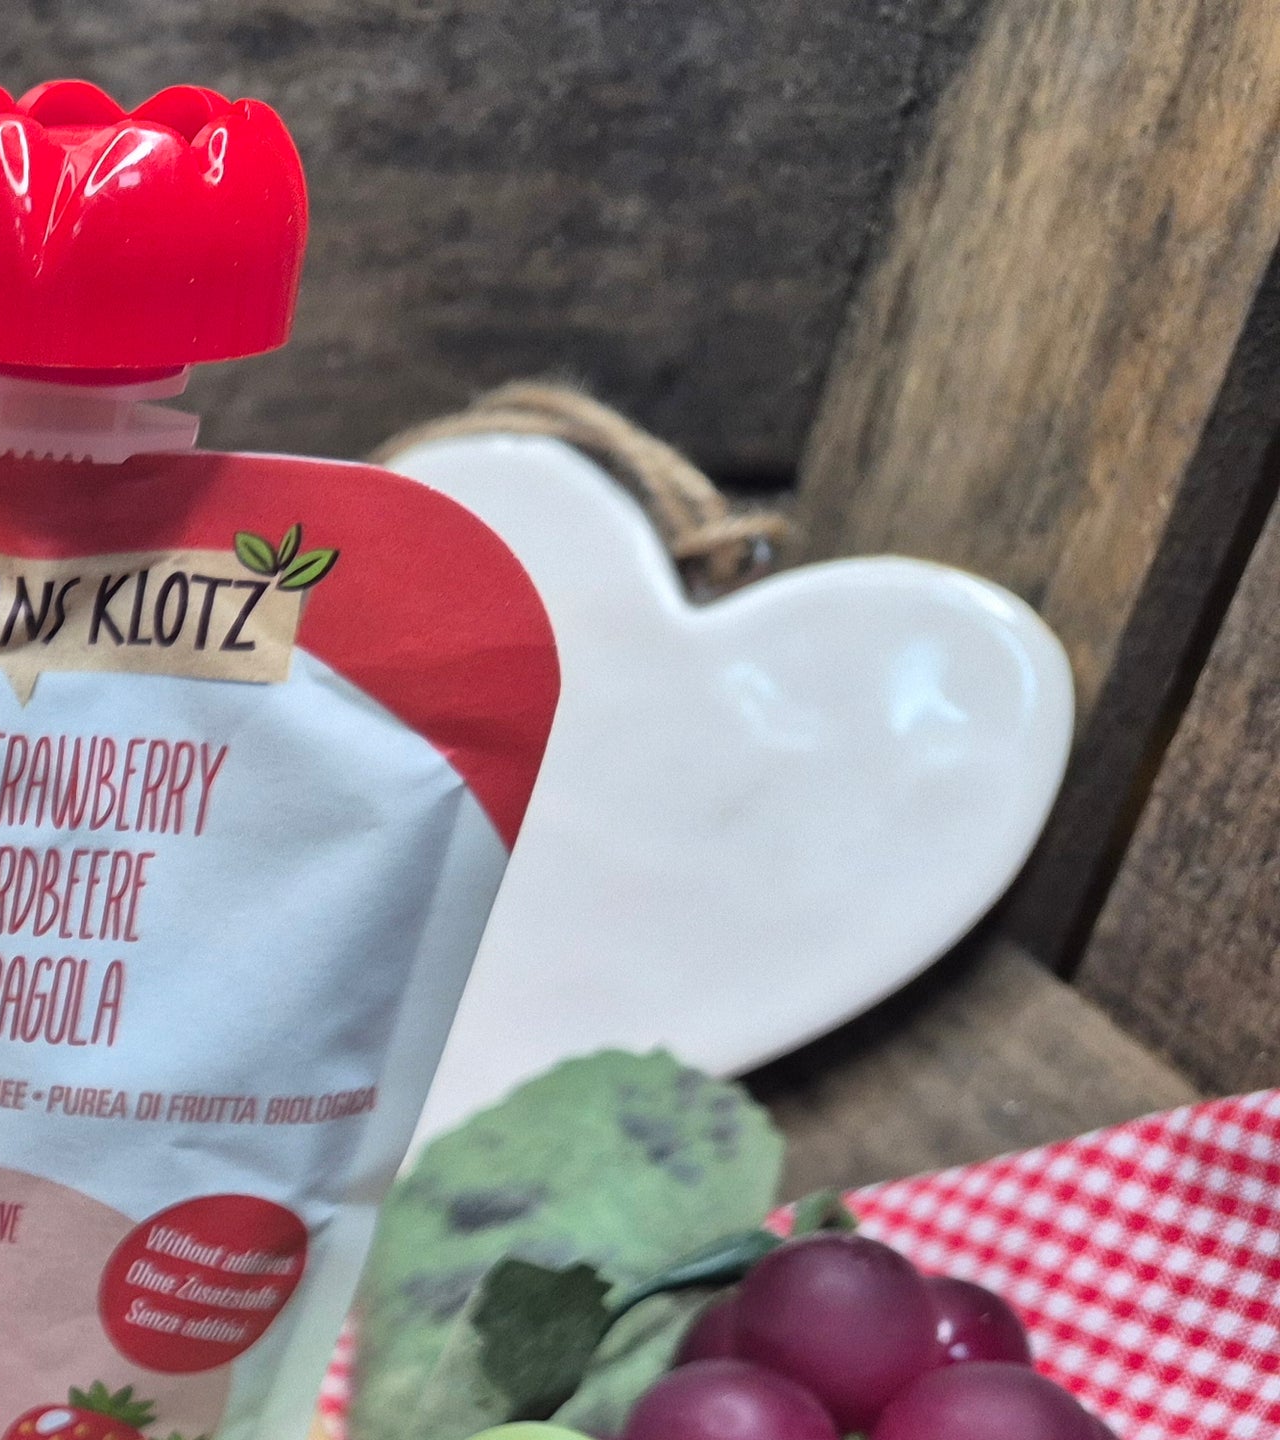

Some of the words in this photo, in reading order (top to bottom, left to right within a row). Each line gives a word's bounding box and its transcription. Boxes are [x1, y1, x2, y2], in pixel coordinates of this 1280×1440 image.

[88, 571, 272, 652] KLOTZ
[45, 1085, 127, 1120] PUREA
[134, 1091, 163, 1121] DI
[165, 1095, 257, 1124] FRUTTA
